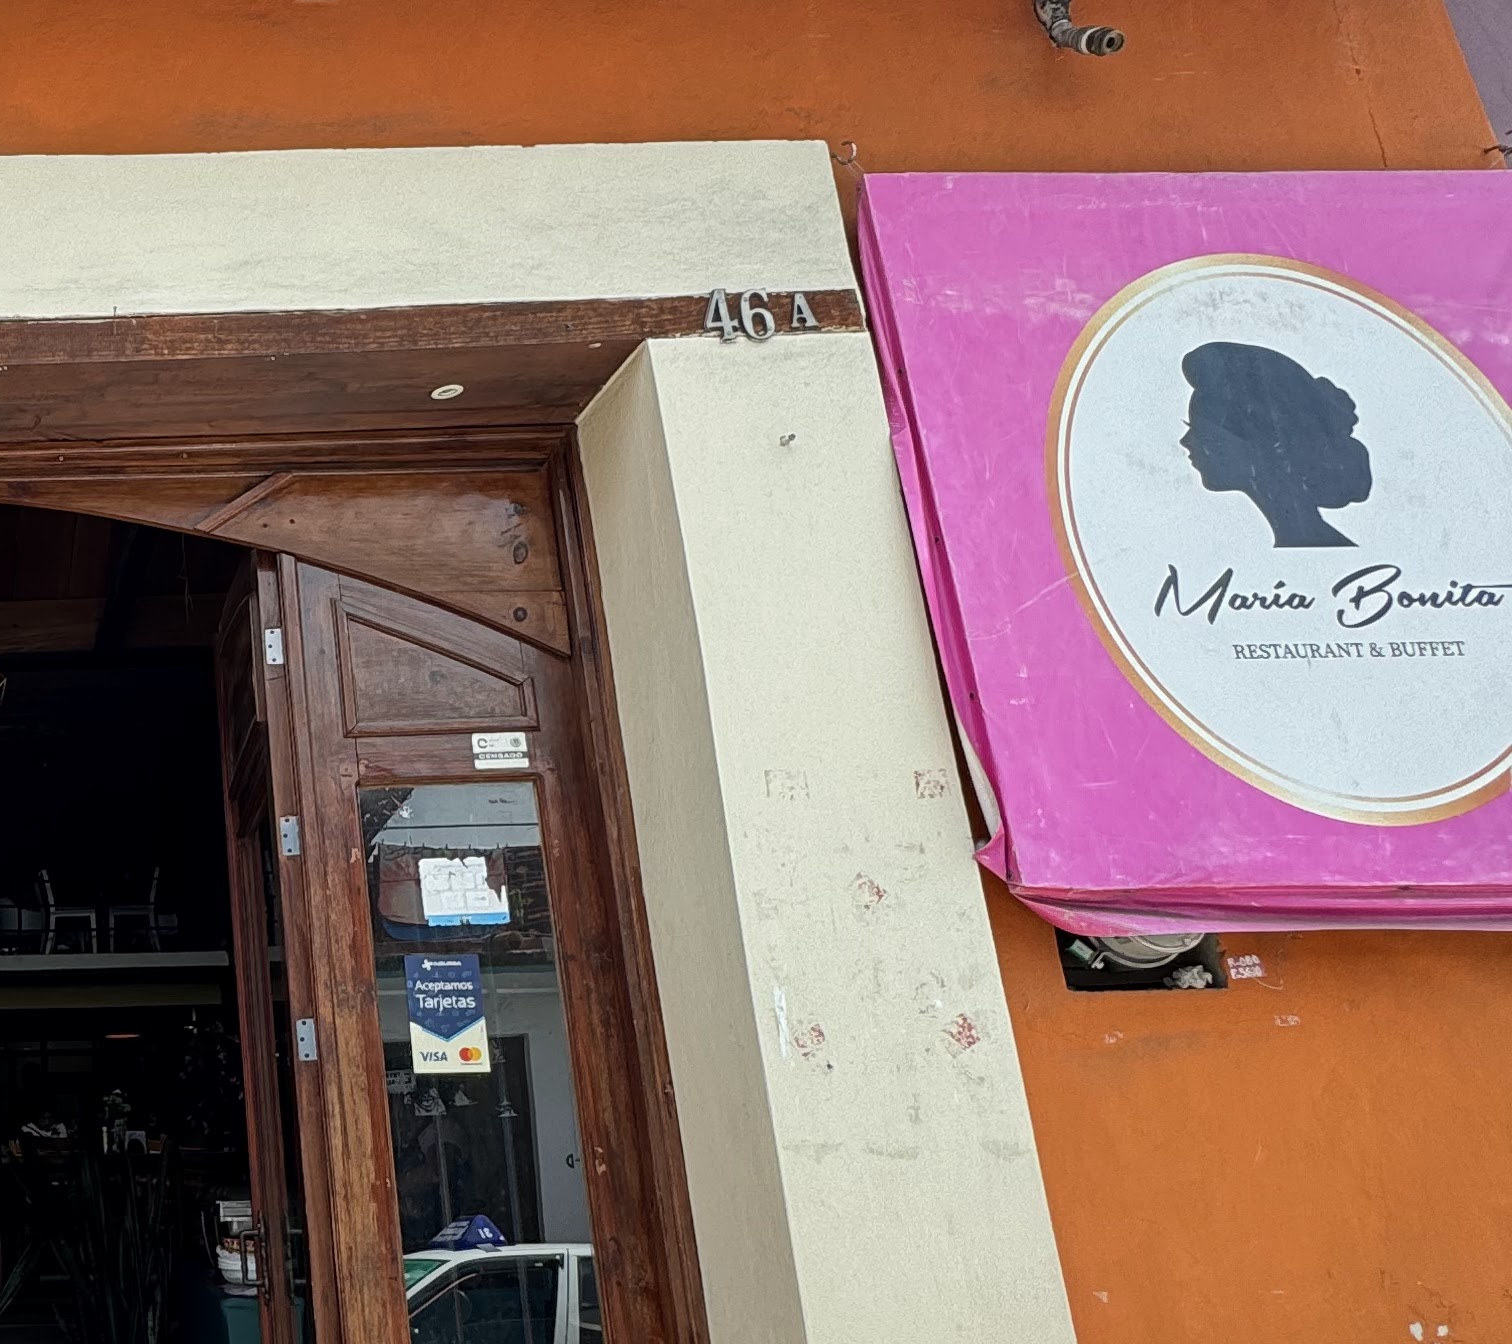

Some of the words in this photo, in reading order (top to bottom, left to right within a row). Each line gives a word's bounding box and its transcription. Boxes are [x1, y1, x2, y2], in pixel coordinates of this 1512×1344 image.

[704, 288, 776, 344] 46
[790, 292, 820, 331] A
[1154, 563, 1316, 625] María
[1331, 564, 1512, 629] Bonita
[1232, 642, 1364, 660] RESTAURANT
[1369, 642, 1386, 658] &
[1389, 640, 1466, 657] BUFFET
[478, 751, 524, 760] CENSADO
[414, 979, 474, 993] Aceptamos
[415, 994, 476, 1013] Tarjetas
[419, 1051, 448, 1062] VISA
